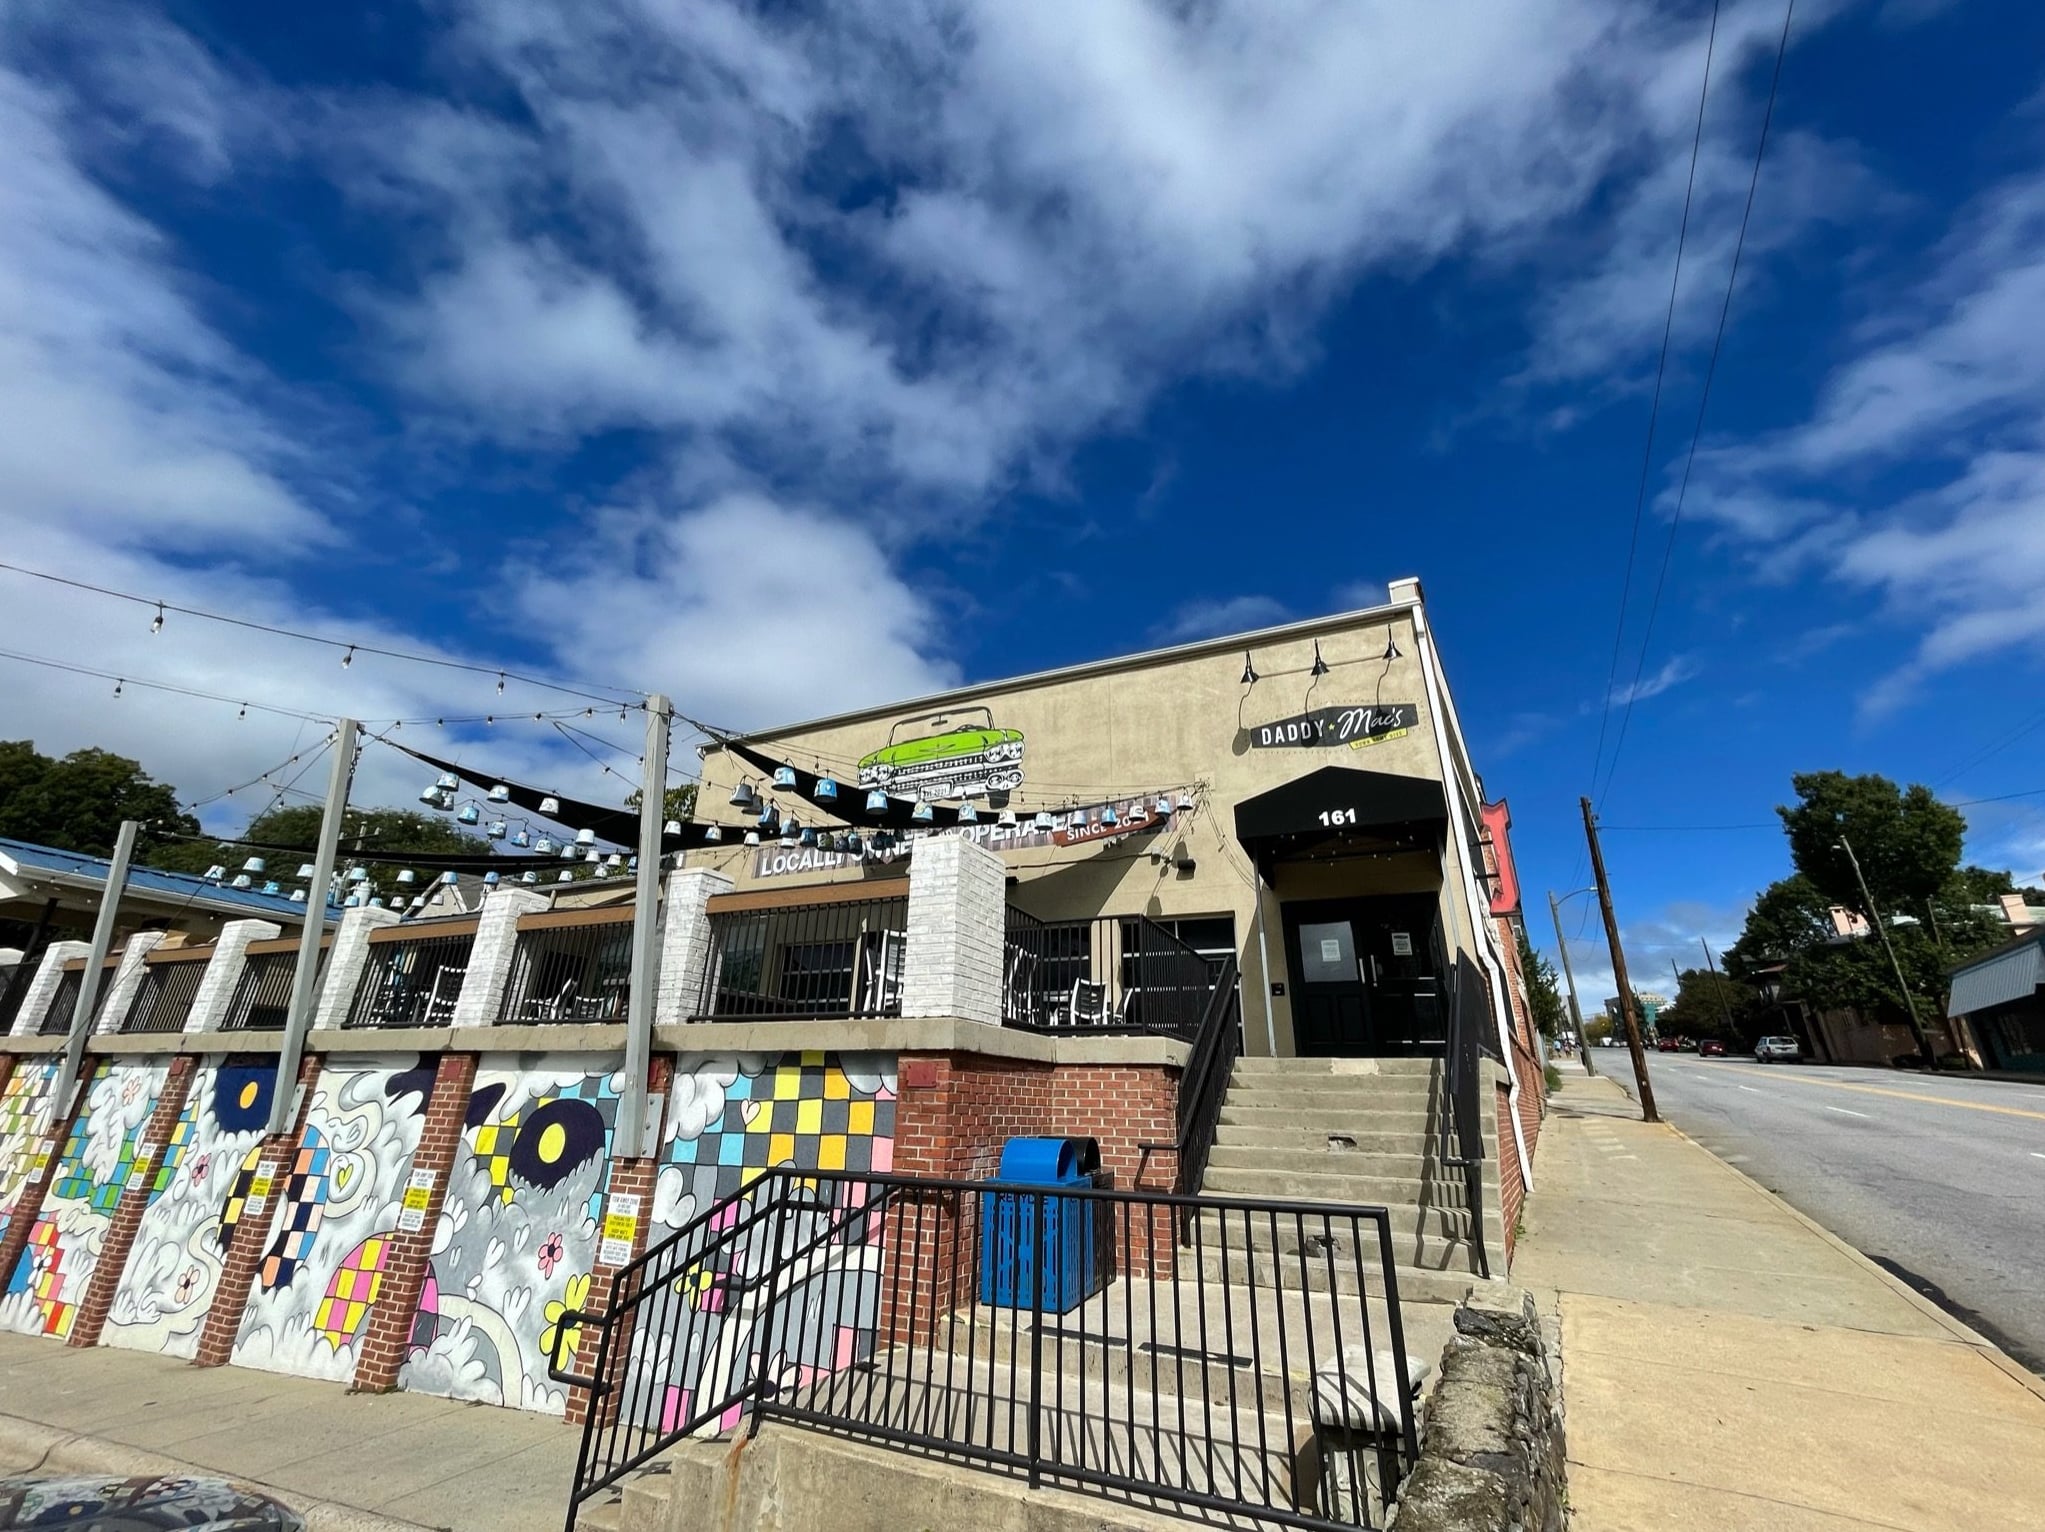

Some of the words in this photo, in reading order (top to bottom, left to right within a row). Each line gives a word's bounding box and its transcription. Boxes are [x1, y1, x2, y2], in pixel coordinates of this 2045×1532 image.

[1261, 719, 1324, 745] DADDY
[1337, 707, 1403, 739] Mac's
[1318, 807, 1356, 827] 161
